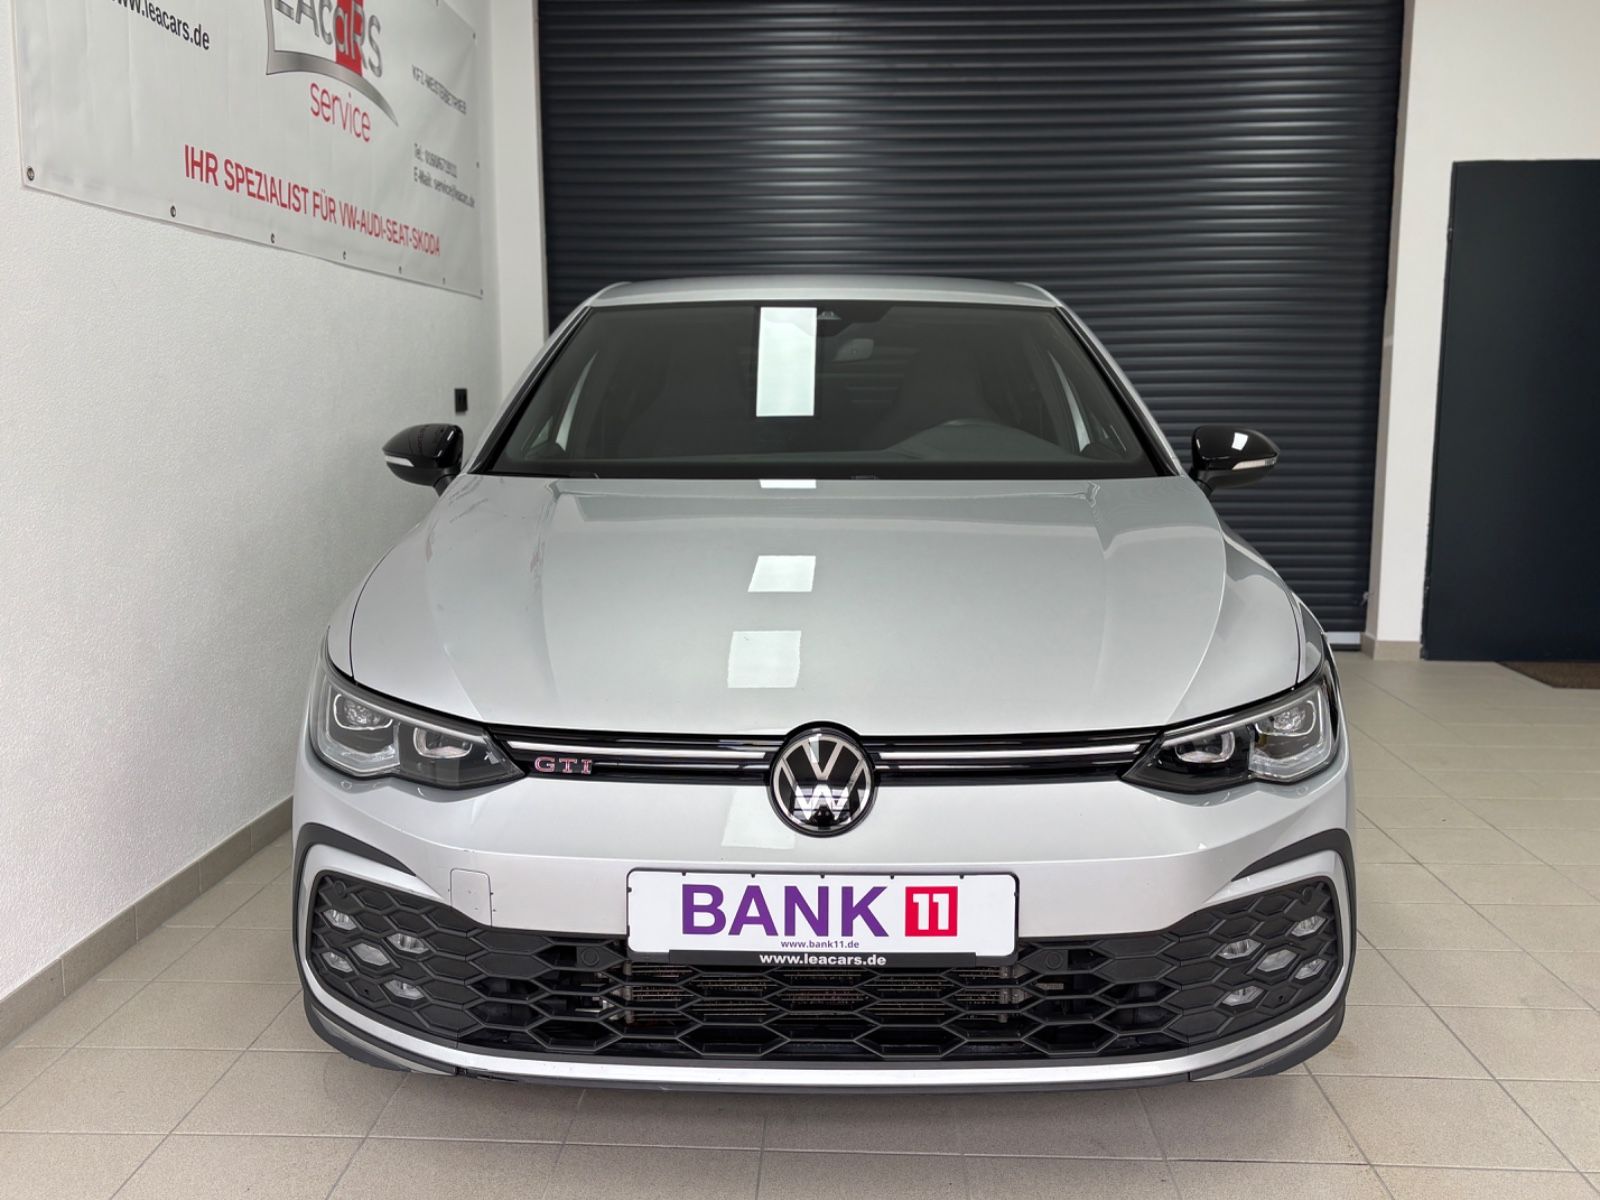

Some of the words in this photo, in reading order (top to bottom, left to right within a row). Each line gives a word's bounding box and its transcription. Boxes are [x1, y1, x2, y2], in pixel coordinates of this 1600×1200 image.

[111, 0, 210, 50] w.leacars.de
[310, 82, 371, 142] service
[184, 143, 218, 187] IHR
[224, 158, 309, 215] SPEZIALIST
[312, 188, 337, 224] FÜR
[339, 200, 441, 257] VW-AUDI-SEAT-SKODA
[534, 756, 593, 775] GTI
[681, 883, 889, 937] BANK
[911, 892, 951, 932] 11
[759, 952, 887, 967] www.leacars.de
[780, 940, 860, 949] www.bank11.de
